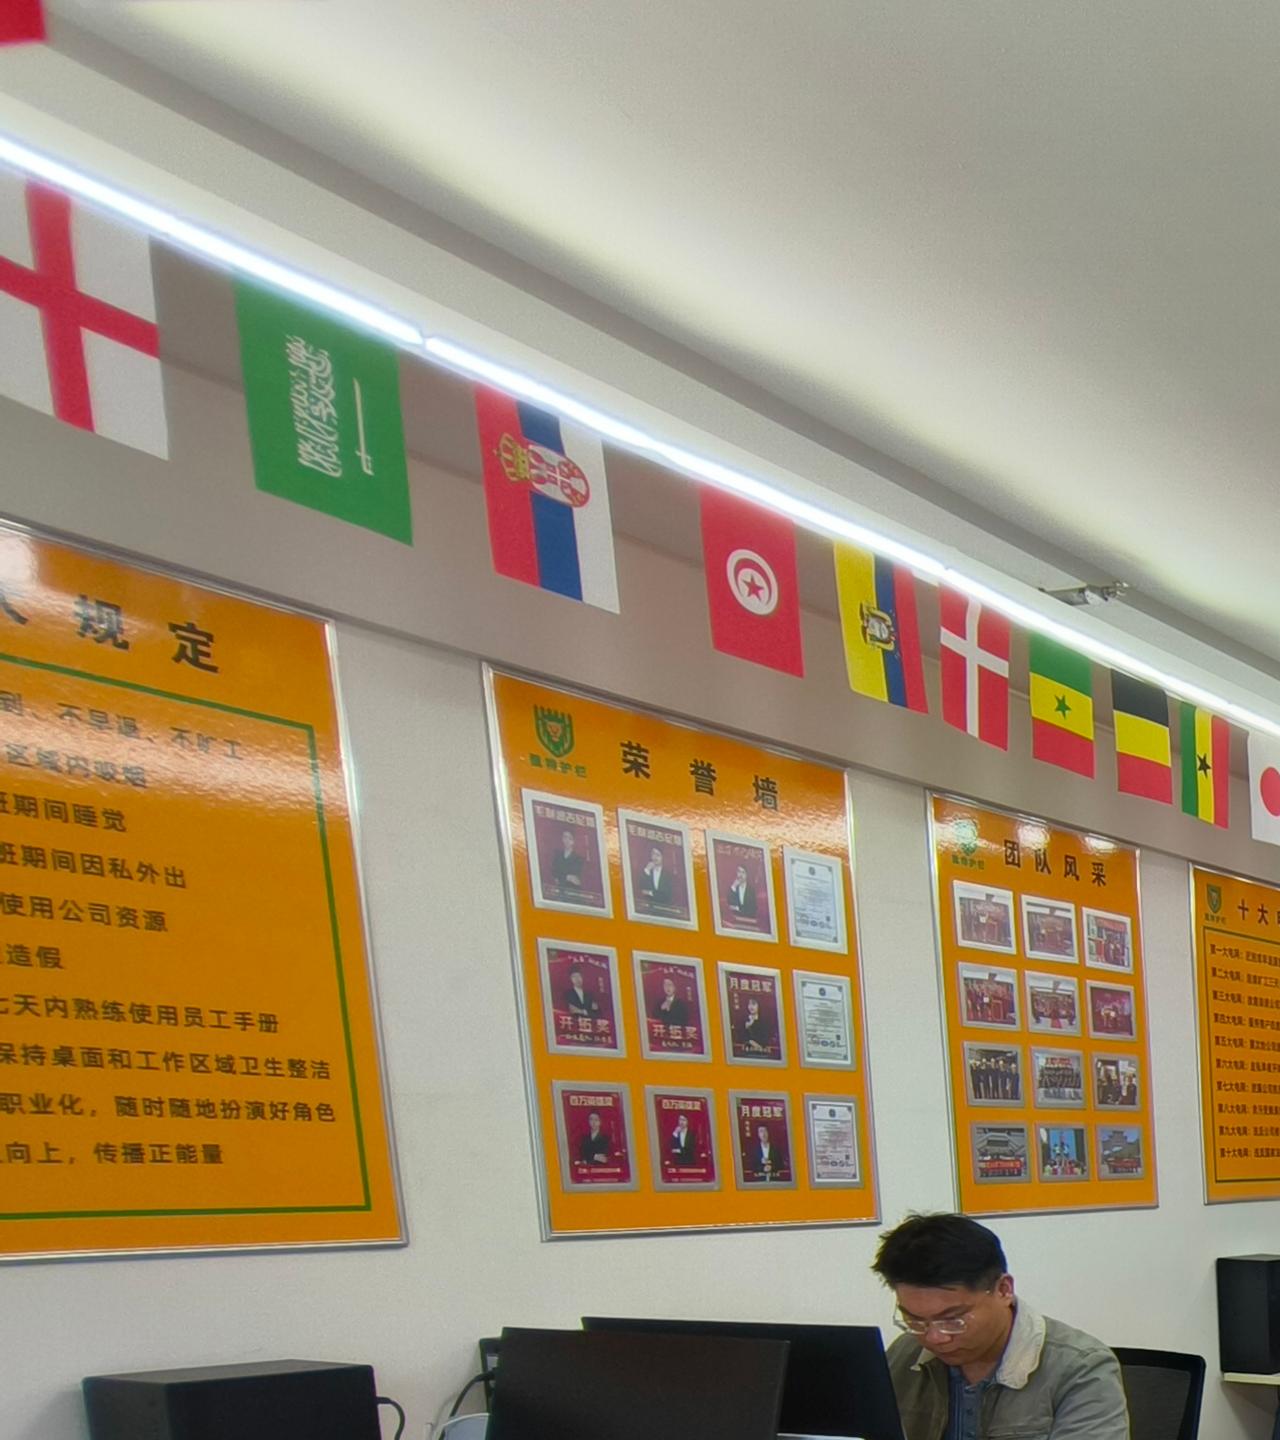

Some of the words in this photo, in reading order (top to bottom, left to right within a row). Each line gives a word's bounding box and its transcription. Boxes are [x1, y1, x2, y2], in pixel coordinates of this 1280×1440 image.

[619, 740, 778, 811] 荣誉墙
[1003, 838, 1107, 887] 团队风采
